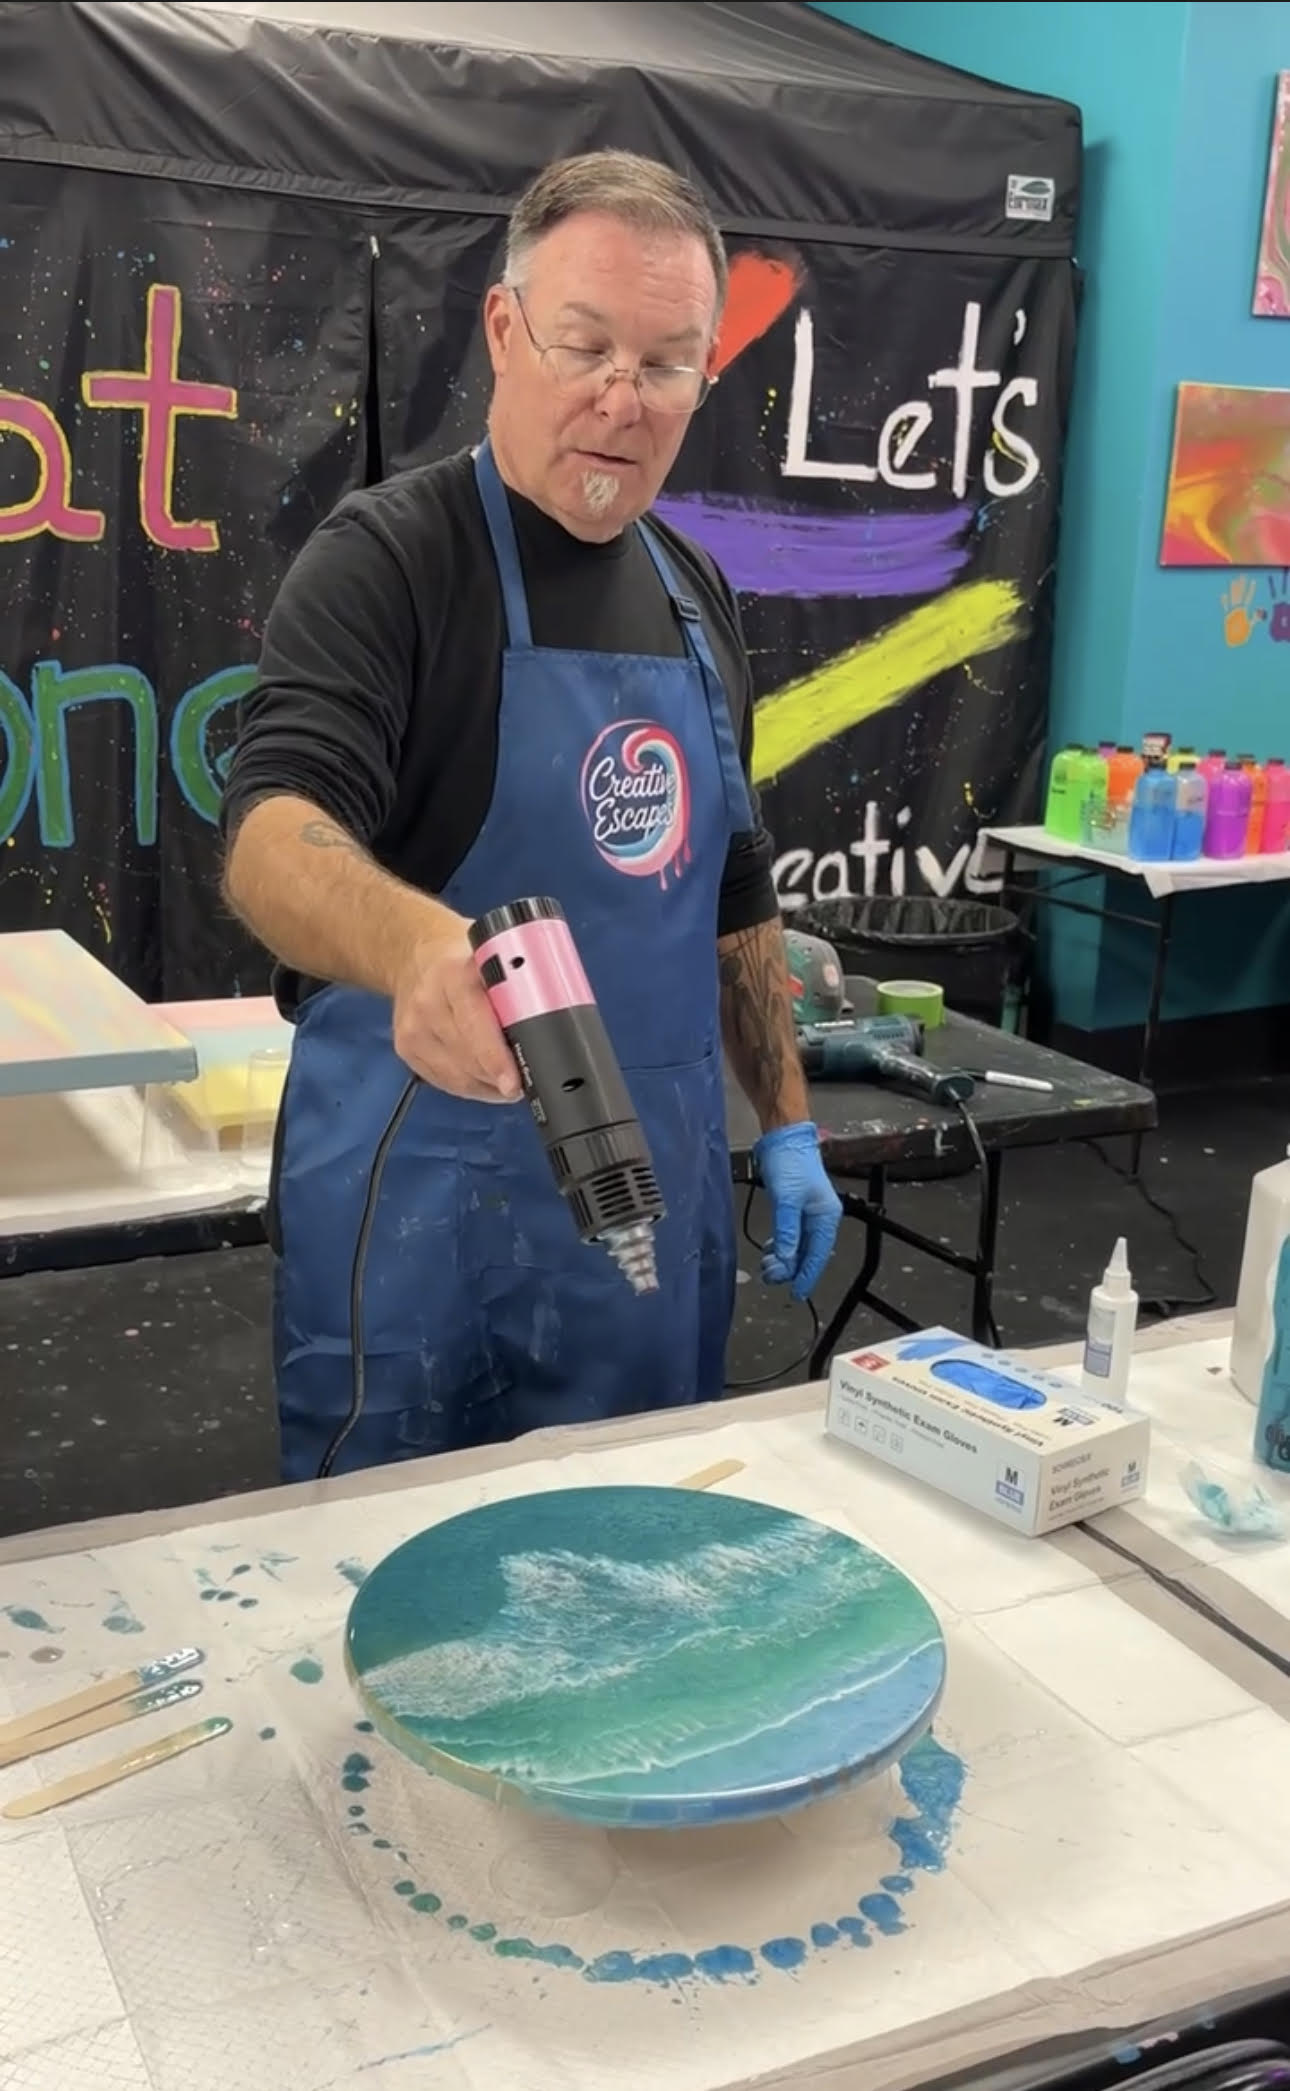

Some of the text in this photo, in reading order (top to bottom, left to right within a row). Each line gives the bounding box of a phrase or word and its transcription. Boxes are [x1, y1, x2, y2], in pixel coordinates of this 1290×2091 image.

[781, 302, 1040, 499] Let's
[589, 756, 677, 801] Creative
[594, 797, 674, 841] Escapes
[840, 1379, 864, 1398] Vinyl
[865, 1392, 911, 1420] Synthetic
[913, 1414, 941, 1435] Exam
[943, 1430, 978, 1453] Gloves
[1005, 1467, 1019, 1486] M
